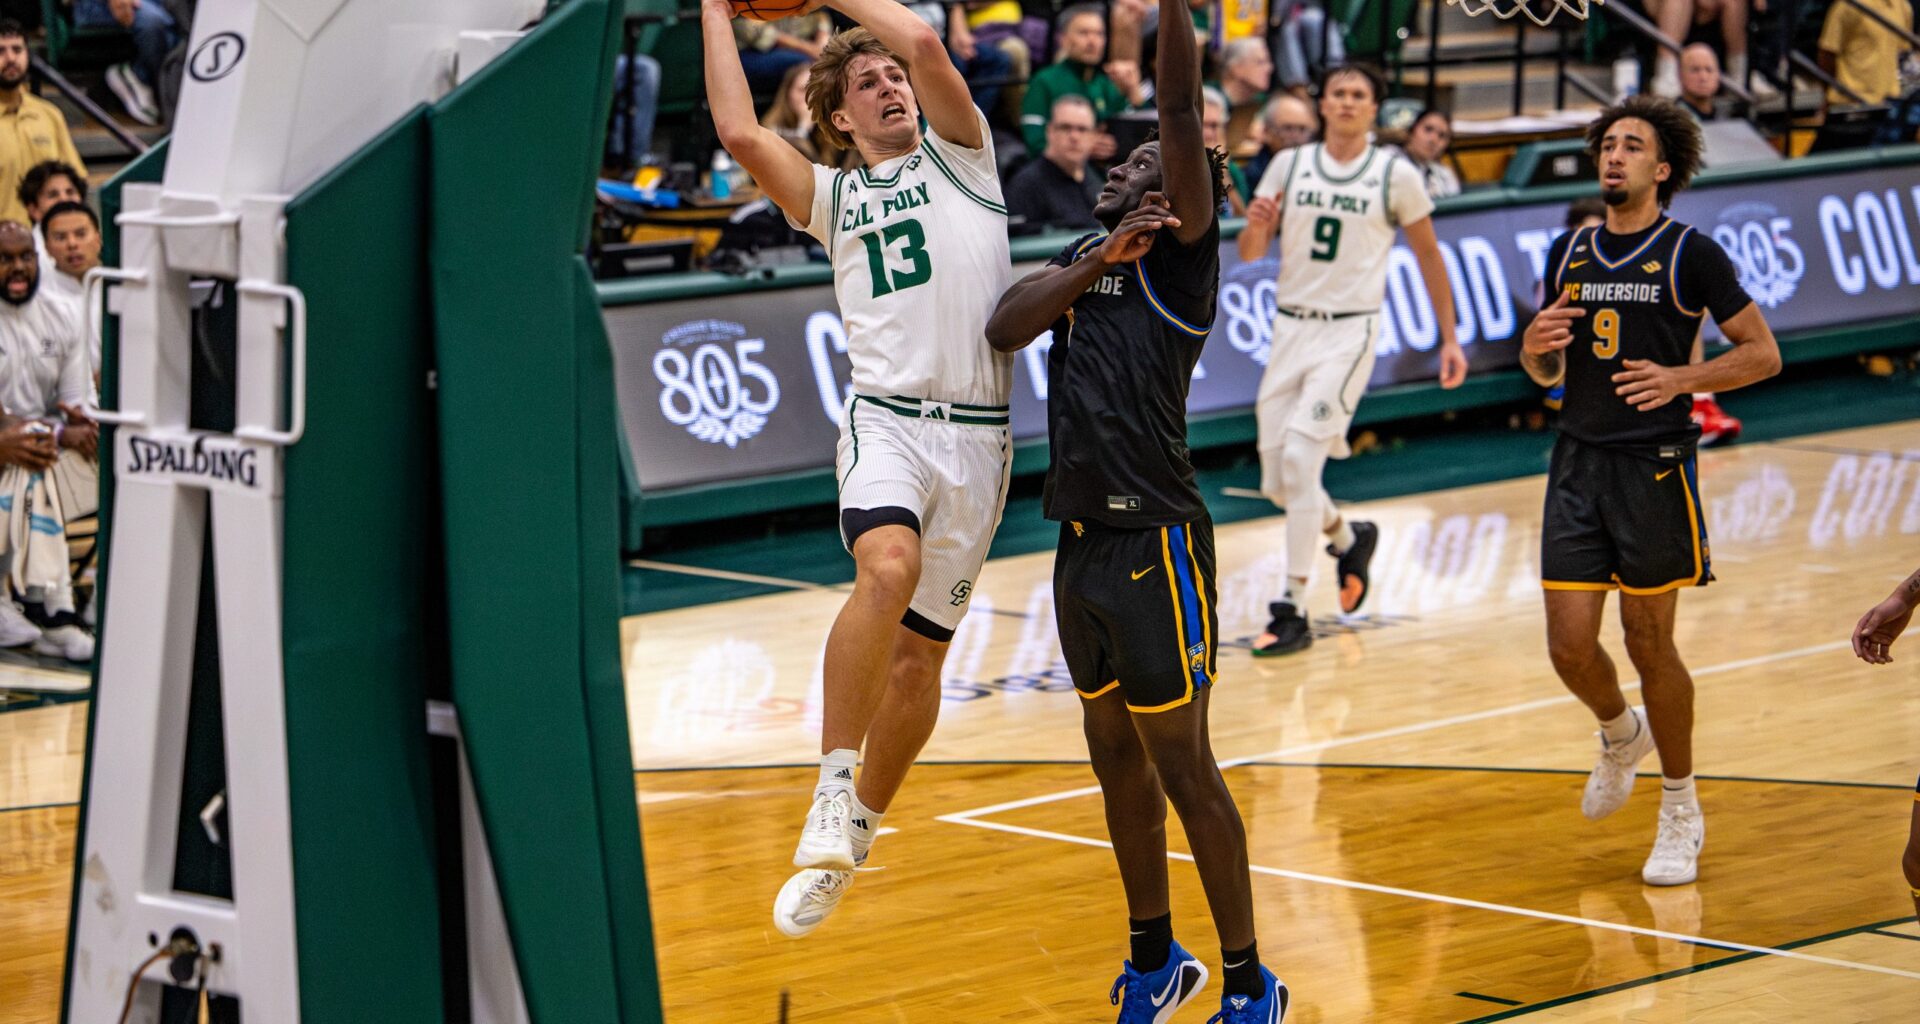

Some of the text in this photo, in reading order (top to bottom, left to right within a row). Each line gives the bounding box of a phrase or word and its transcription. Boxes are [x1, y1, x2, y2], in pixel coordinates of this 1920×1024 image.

[842, 181, 931, 232] CAL POLY
[1296, 190, 1370, 215] CAL POLY
[858, 218, 932, 299] 13
[1310, 215, 1342, 263] 9
[1712, 217, 1805, 285] 805
[1818, 184, 1920, 294] COL
[1581, 282, 1662, 304] RIVERSIDE
[1592, 308, 1620, 360] 9
[653, 337, 781, 426] 805
[128, 435, 257, 487] SPALDING
